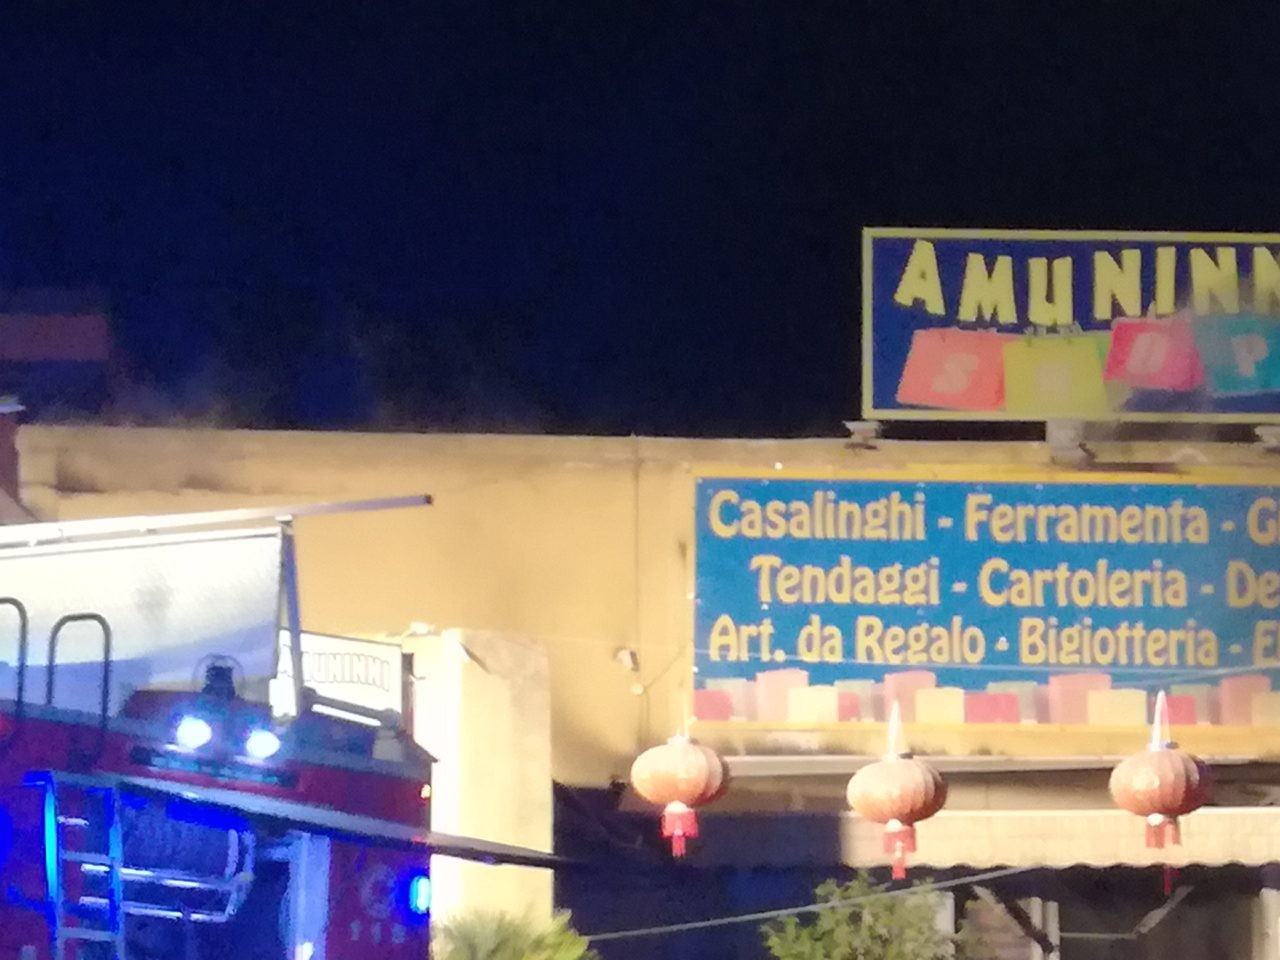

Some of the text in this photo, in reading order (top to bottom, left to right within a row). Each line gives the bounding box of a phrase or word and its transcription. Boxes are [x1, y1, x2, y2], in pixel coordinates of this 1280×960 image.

[708, 489, 926, 541] Casalinghi
[964, 493, 1209, 544] Ferramenta
[750, 555, 940, 606] Tendaggi
[977, 557, 1187, 608] Cartoleria
[709, 613, 786, 662] Art.
[798, 615, 843, 662] da
[856, 614, 986, 664] Regalo
[1019, 616, 1219, 666] Bigiotteria
